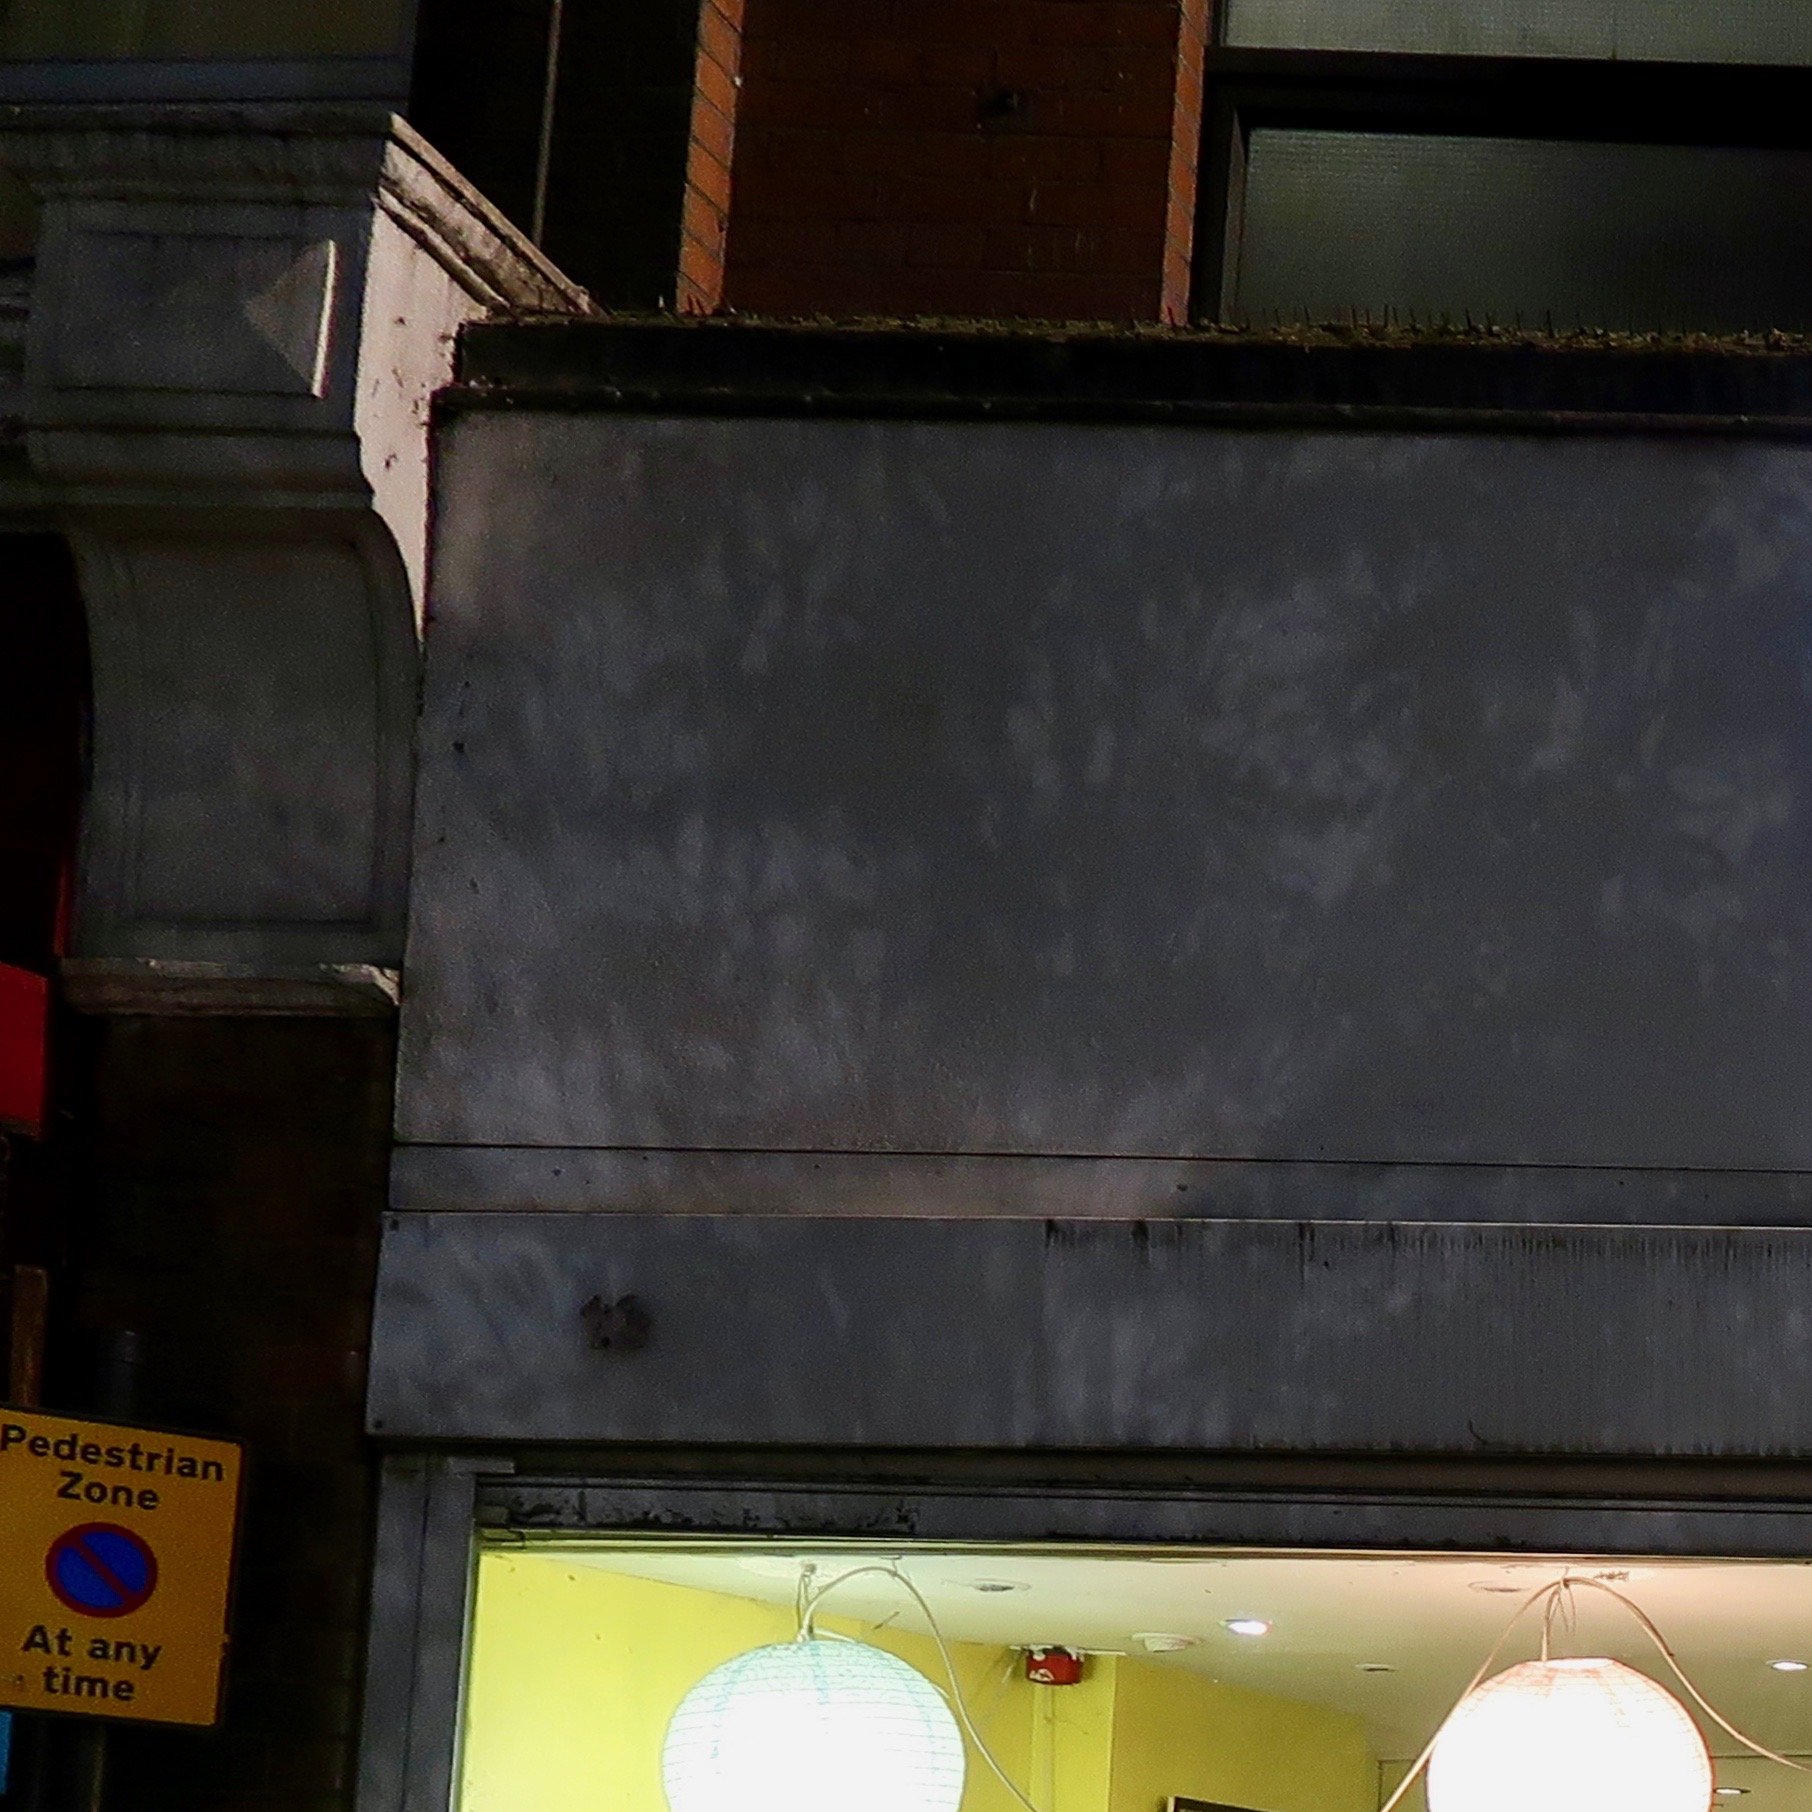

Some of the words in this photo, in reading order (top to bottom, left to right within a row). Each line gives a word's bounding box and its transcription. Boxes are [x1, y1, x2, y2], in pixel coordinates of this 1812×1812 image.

[1, 1423, 224, 1482] Pedestrian
[57, 1470, 160, 1511] Zone
[22, 1624, 73, 1657] At
[88, 1638, 162, 1671] any
[43, 1666, 136, 1701] time
